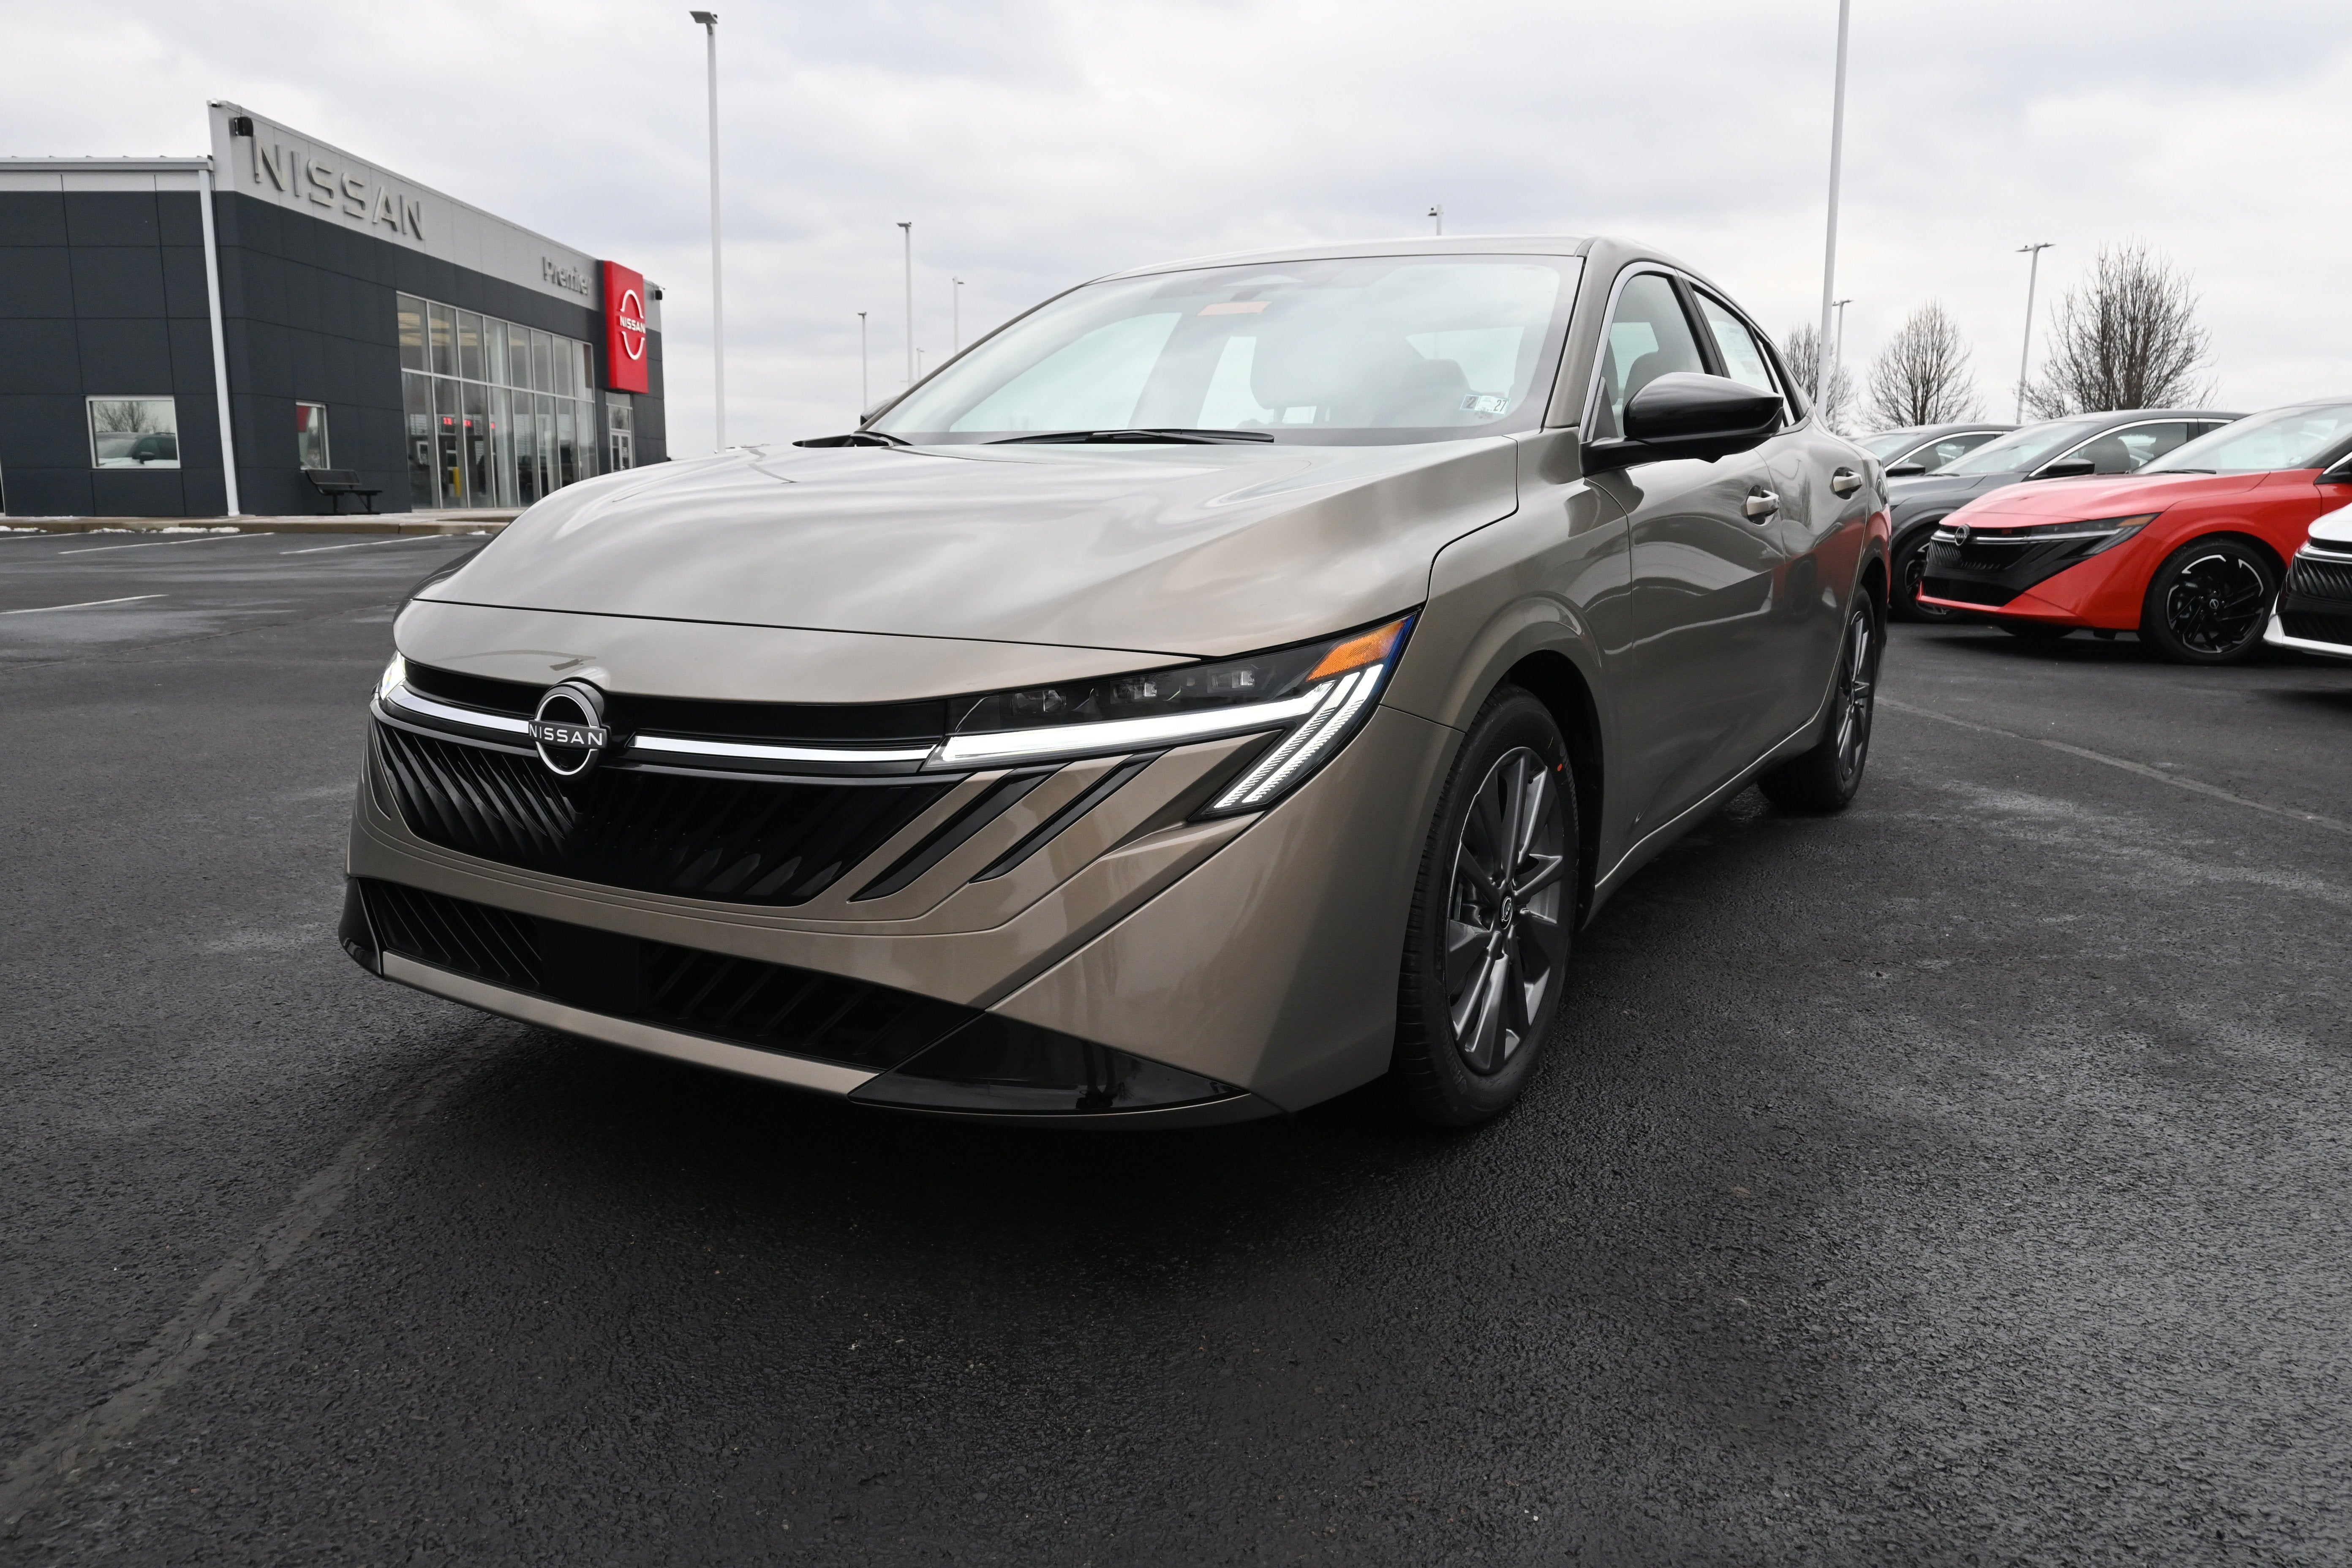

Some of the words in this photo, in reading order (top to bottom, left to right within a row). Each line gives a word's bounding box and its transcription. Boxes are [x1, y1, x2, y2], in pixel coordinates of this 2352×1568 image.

[252, 134, 423, 240] NISSAN
[542, 256, 592, 297] Premier
[620, 315, 645, 334] NISSAN
[1466, 396, 1477, 408] 2
[1493, 400, 1508, 412] 27
[529, 724, 603, 746] NISSAN
